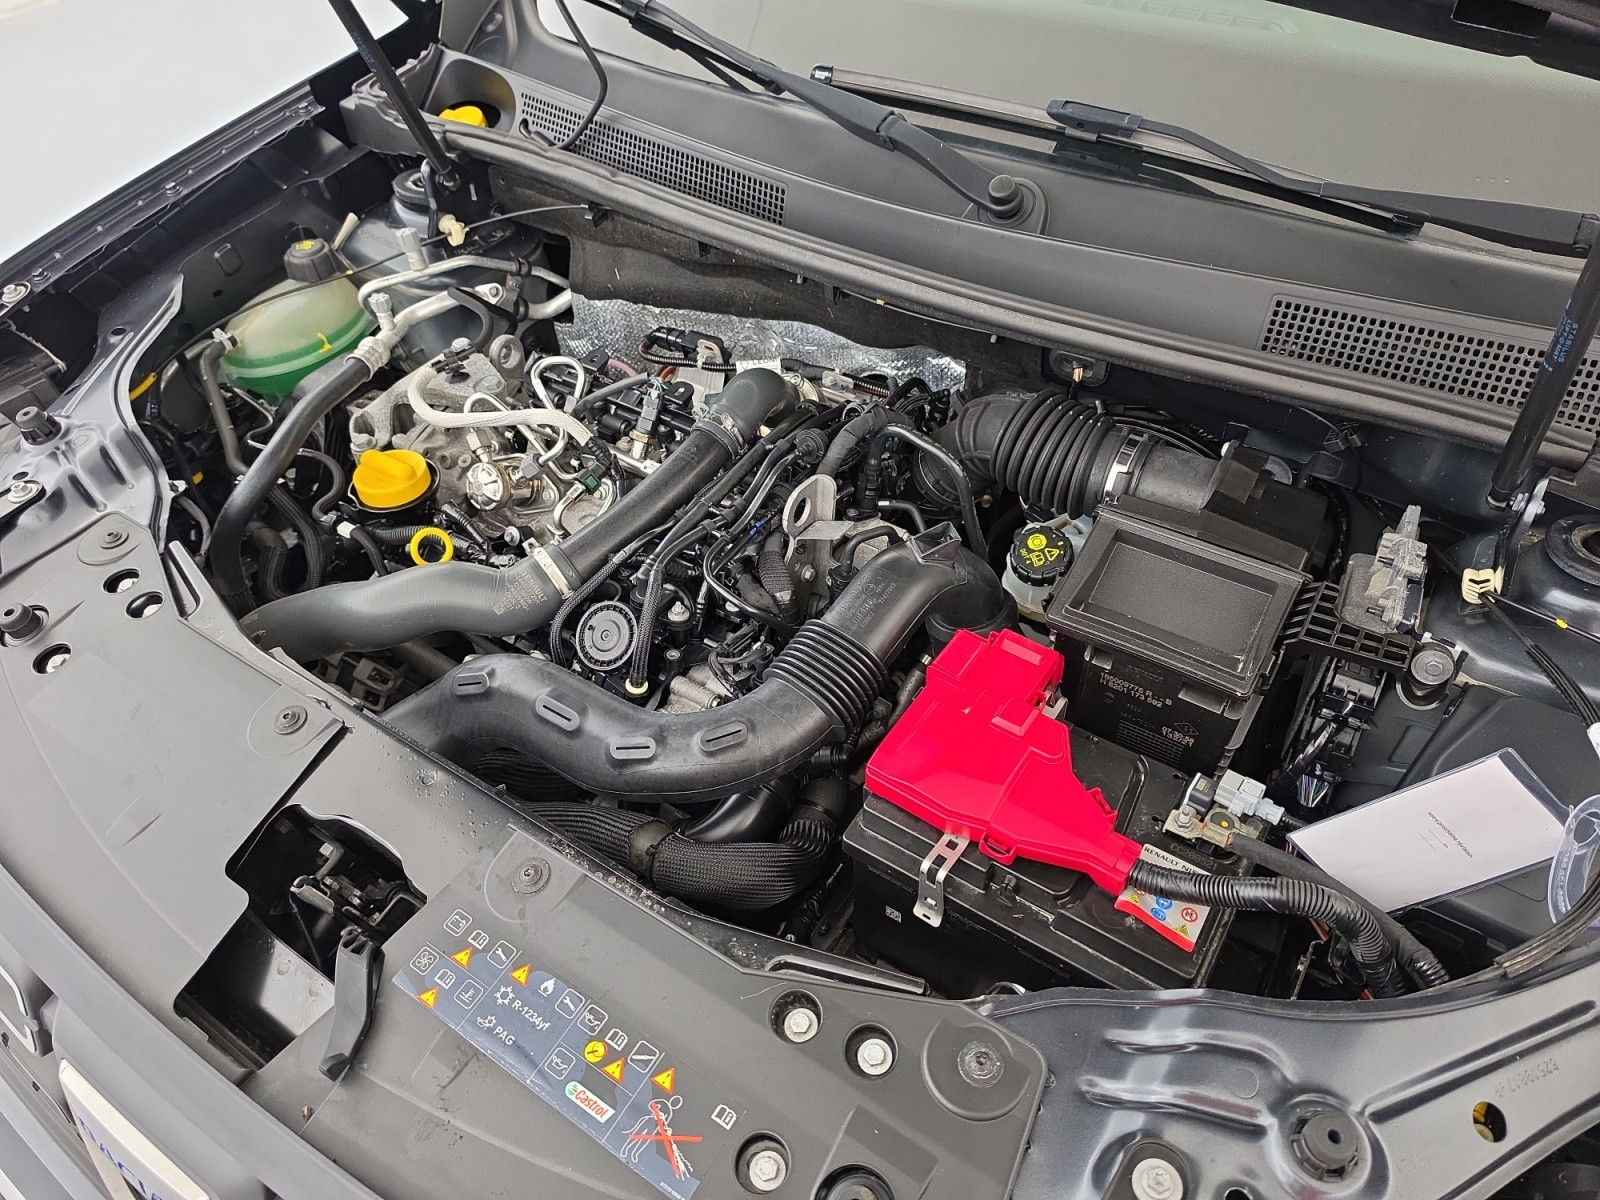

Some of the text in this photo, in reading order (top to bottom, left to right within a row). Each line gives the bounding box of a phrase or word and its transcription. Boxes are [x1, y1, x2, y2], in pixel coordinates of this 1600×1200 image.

[1558, 322, 1579, 362] STABILUS
[1020, 548, 1030, 559] DOT
[520, 570, 547, 602] RENAULT
[1108, 682, 1127, 693] 8201
[1130, 691, 1145, 700] 173
[1144, 846, 1180, 867] RENAULT
[511, 999, 551, 1031] R-1234yf
[493, 1025, 516, 1045] PAG
[574, 1090, 609, 1119] Castrol
